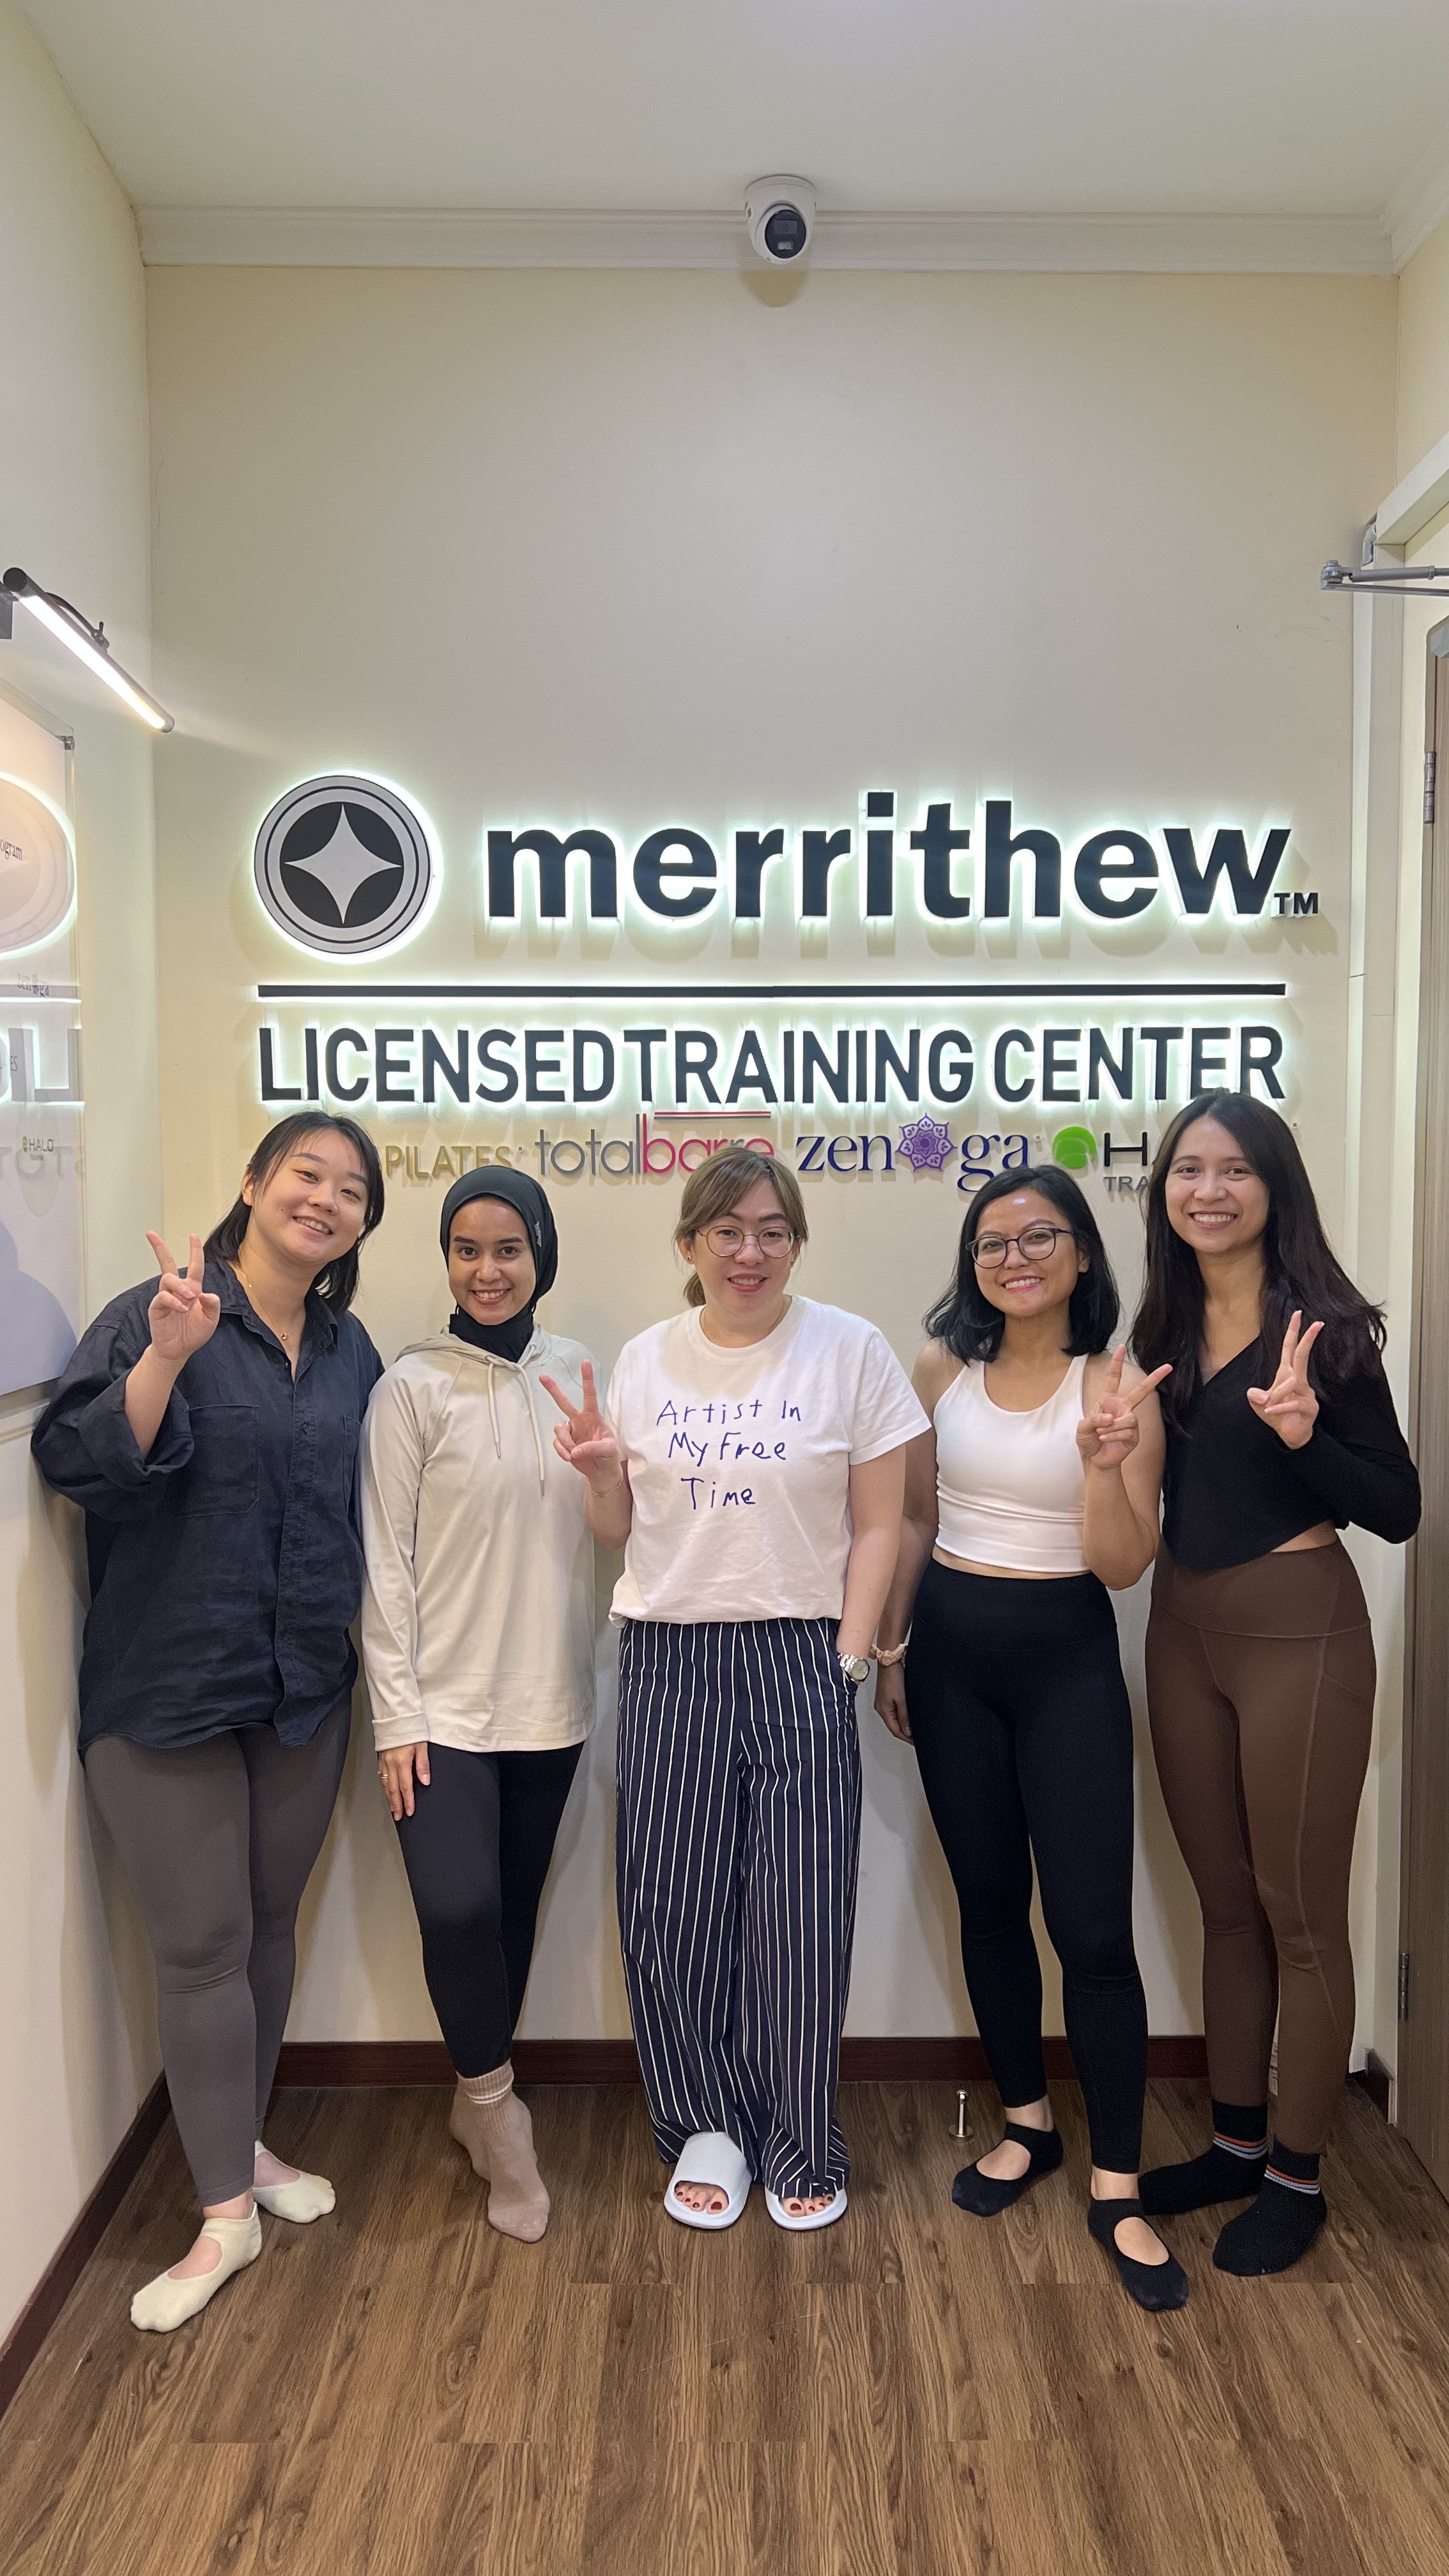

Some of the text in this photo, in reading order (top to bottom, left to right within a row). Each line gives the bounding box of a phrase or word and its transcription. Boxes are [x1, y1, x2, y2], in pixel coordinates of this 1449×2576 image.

[0, 839, 23, 861] ogram
[488, 792, 1292, 919] merrithew
[259, 1026, 1285, 1104] LICENSED TRAINING CENTER
[1103, 1176, 1151, 1192] TRA
[657, 1399, 802, 1426] Artist In
[668, 1431, 787, 1467] My Free
[680, 1477, 756, 1511] Time
